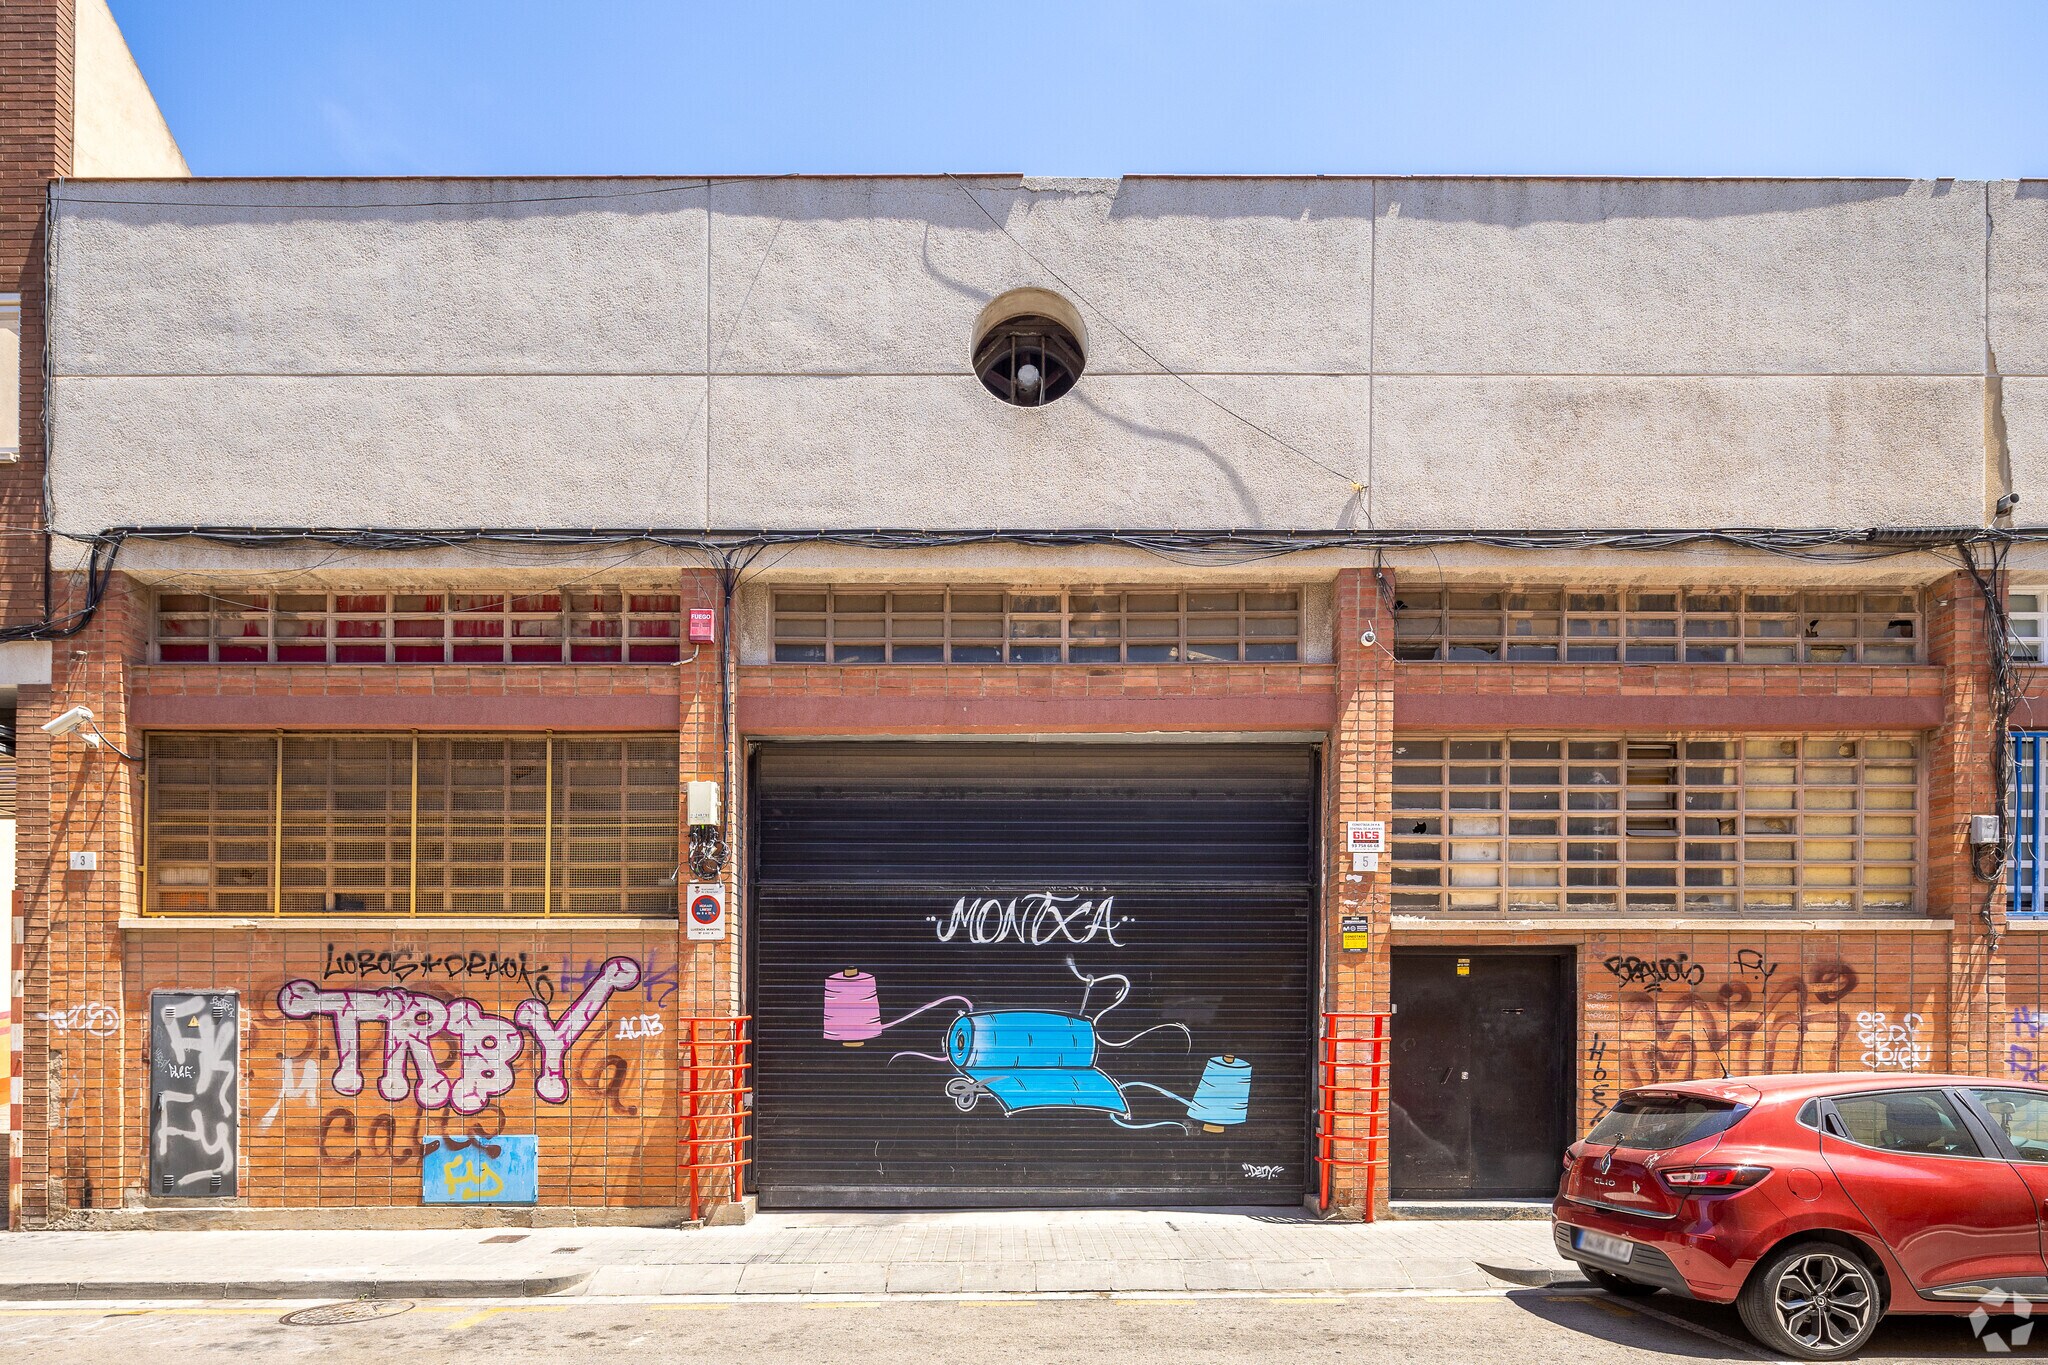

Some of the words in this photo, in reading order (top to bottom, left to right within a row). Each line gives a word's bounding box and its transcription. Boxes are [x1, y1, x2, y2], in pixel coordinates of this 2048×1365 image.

[1352, 831, 1379, 839] GICS
[80, 855, 86, 866] 3
[1362, 856, 1369, 868] 5
[615, 1013, 665, 1040] ACAB
[1594, 1176, 1616, 1187] CLIO
